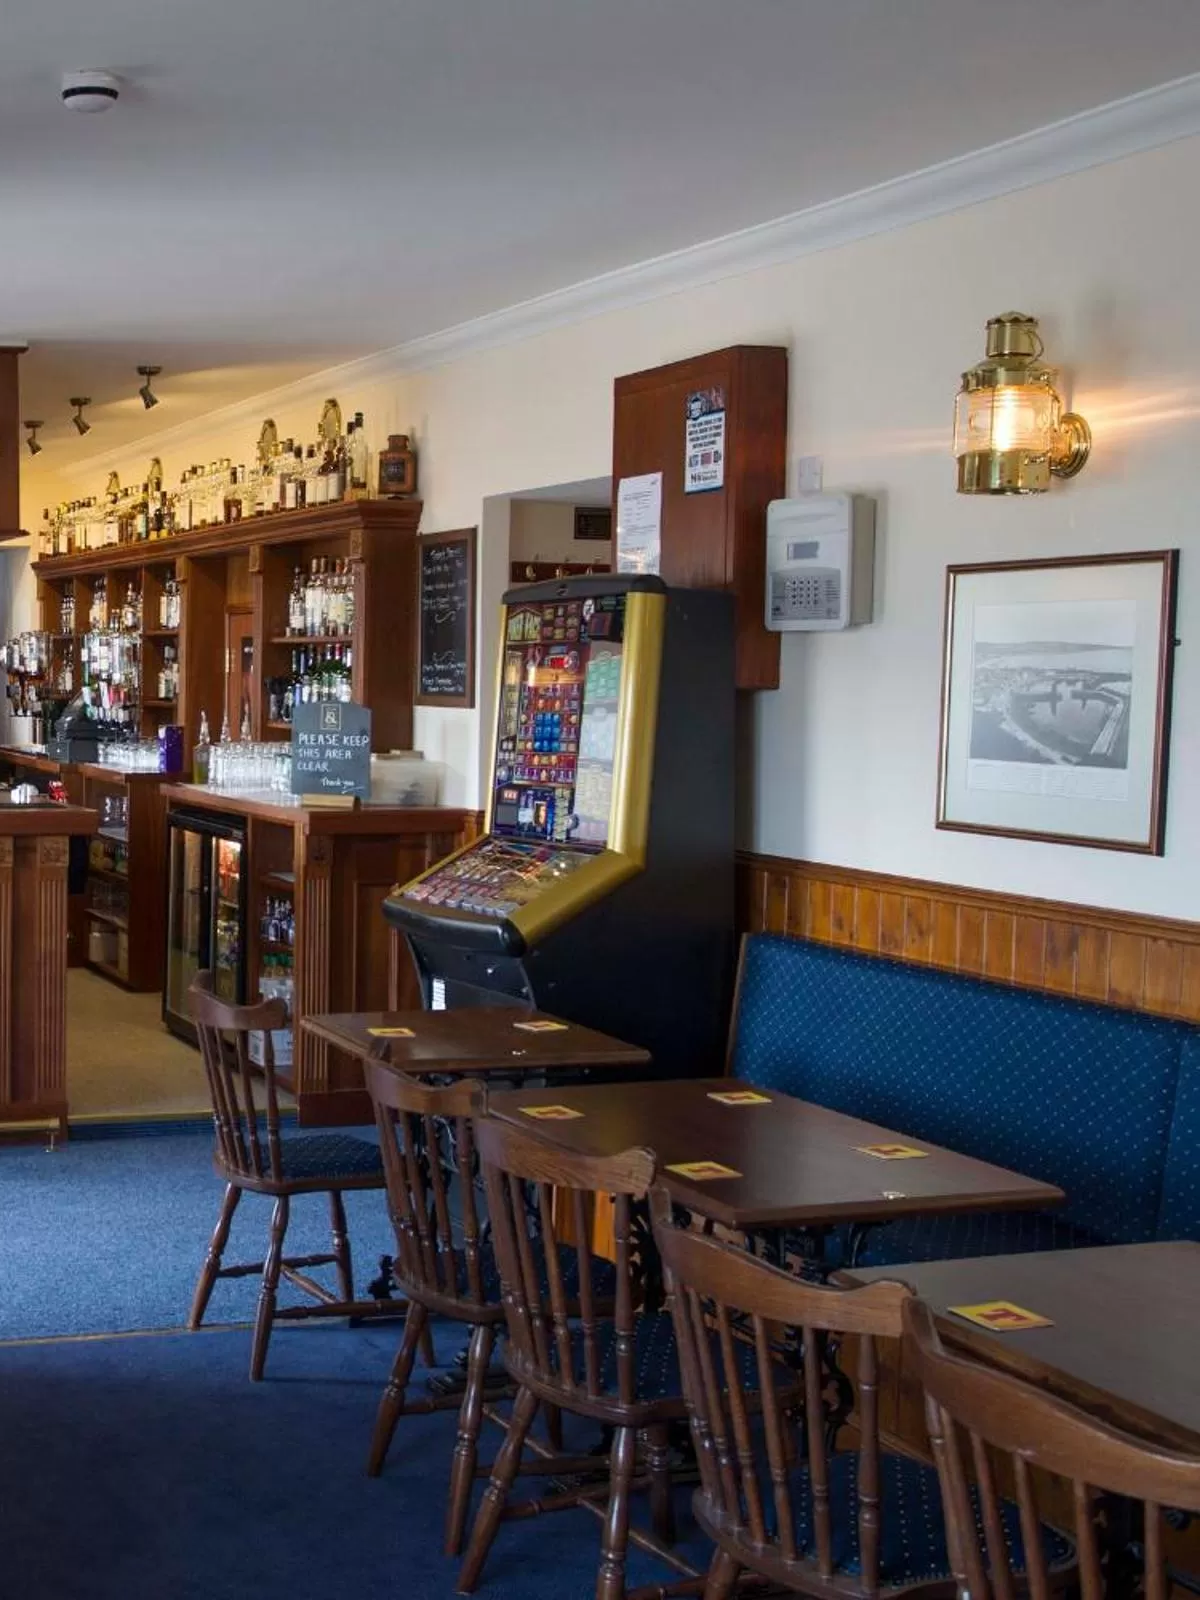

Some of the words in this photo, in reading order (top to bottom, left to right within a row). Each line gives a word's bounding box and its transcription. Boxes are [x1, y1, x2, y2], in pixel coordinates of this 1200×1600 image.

[298, 733, 340, 746] PLEASE
[343, 735, 369, 747] KEEP
[298, 748, 320, 758] THIS
[325, 749, 352, 760] AREA
[297, 761, 330, 772] CLEAR
